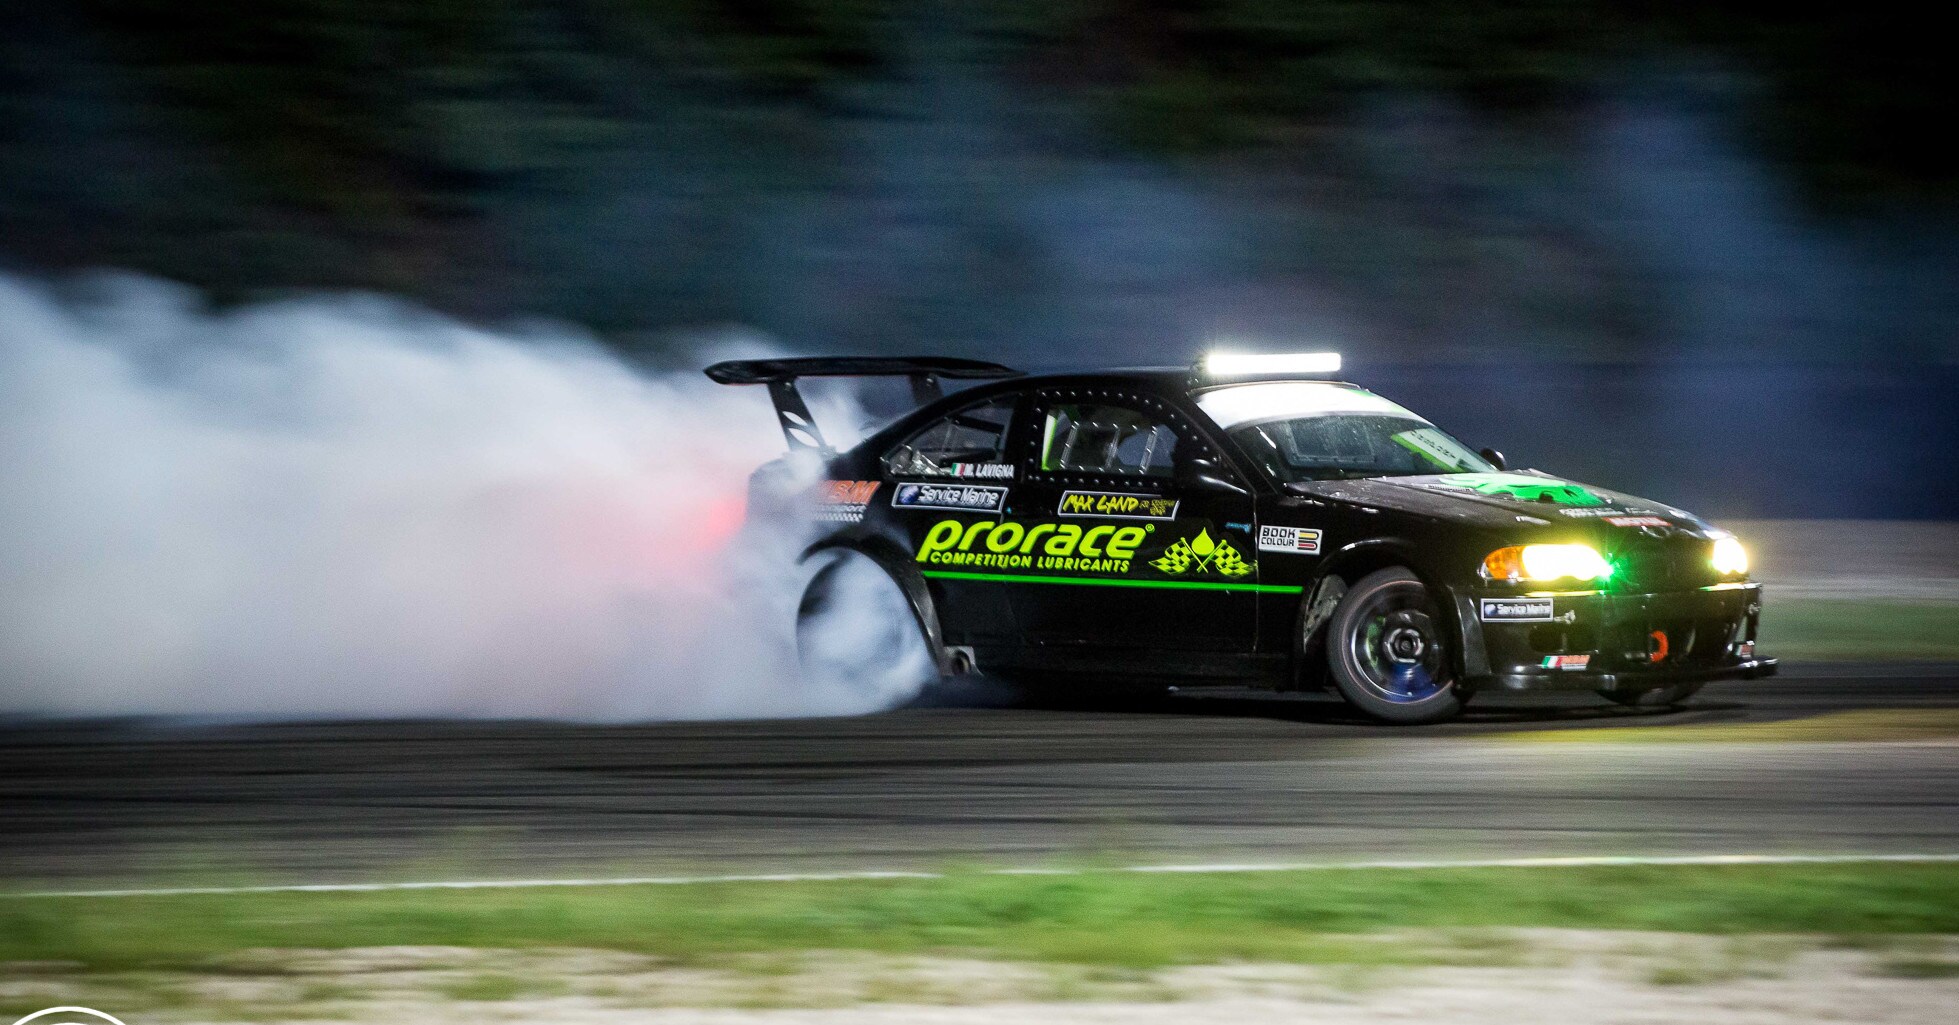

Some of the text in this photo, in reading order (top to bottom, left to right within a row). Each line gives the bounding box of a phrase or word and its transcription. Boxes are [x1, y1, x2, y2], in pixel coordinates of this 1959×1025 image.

[975, 463, 1014, 479] LAVIGNA
[918, 485, 999, 505] Service Marine
[1062, 494, 1095, 513] MAX
[1096, 495, 1139, 514] LAND
[1262, 527, 1296, 539] BOOK
[1261, 537, 1295, 547] COLOUR
[930, 551, 1130, 573] COMPETITION LUBRICANTS
[1497, 603, 1527, 615] Service
